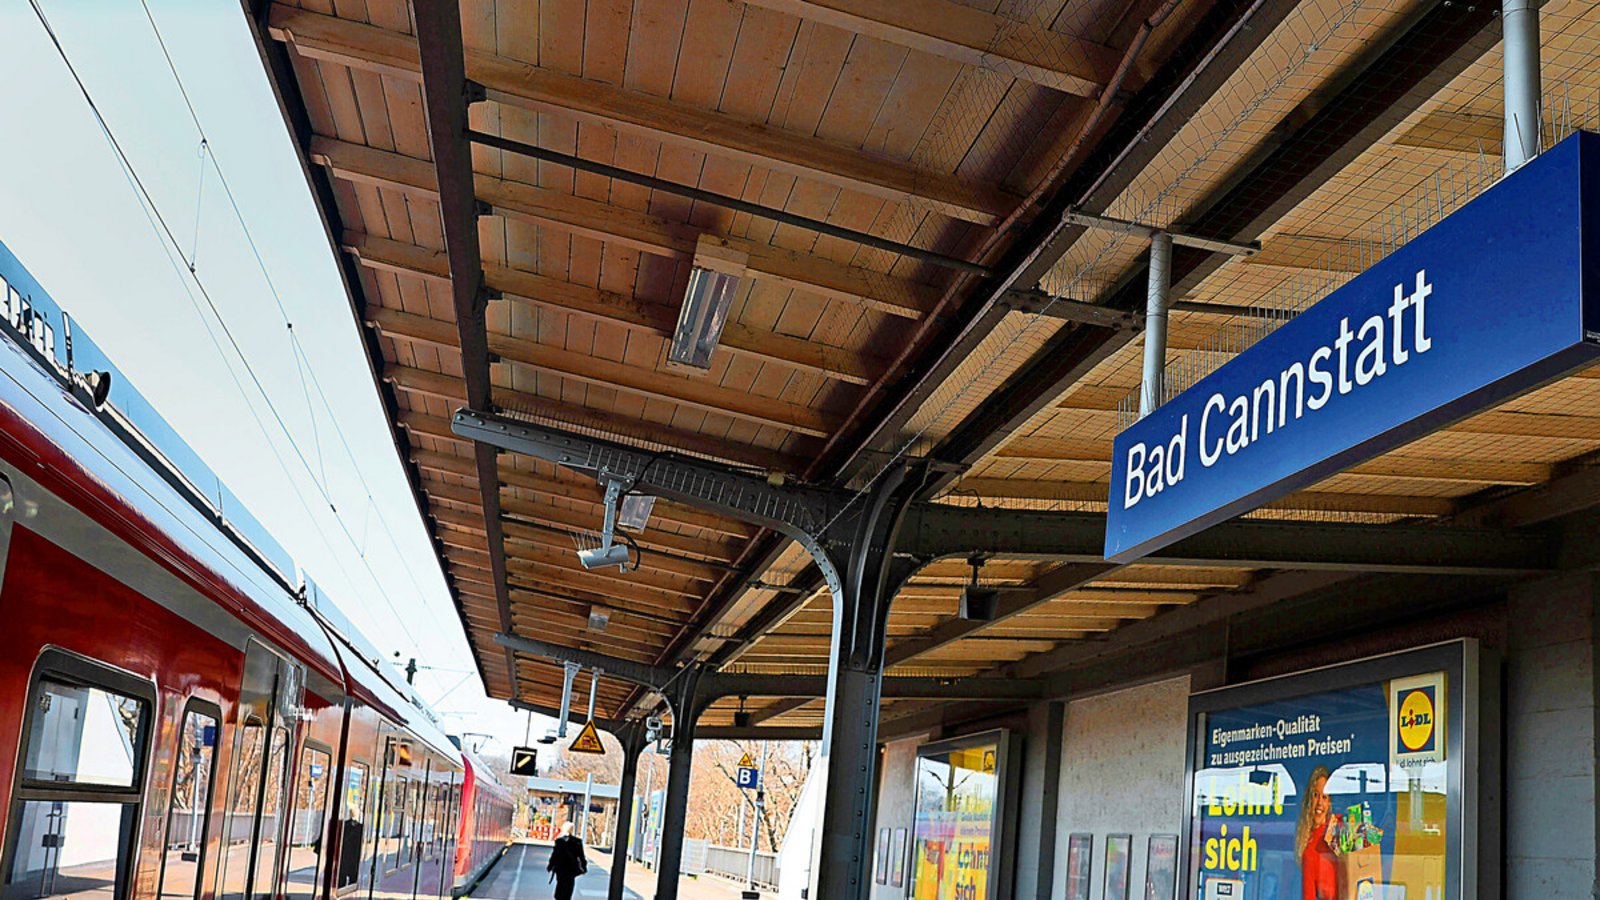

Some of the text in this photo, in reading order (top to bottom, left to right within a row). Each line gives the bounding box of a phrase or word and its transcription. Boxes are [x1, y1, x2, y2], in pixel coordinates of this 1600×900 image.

[1123, 268, 1433, 510] Bad Cannstatt
[1212, 714, 1321, 748] Eigenmarken-Qualität
[1210, 753, 1222, 766] zu
[1223, 743, 1305, 766] ausgezeichneten
[739, 768, 751, 785] B
[1204, 823, 1257, 871] sich
